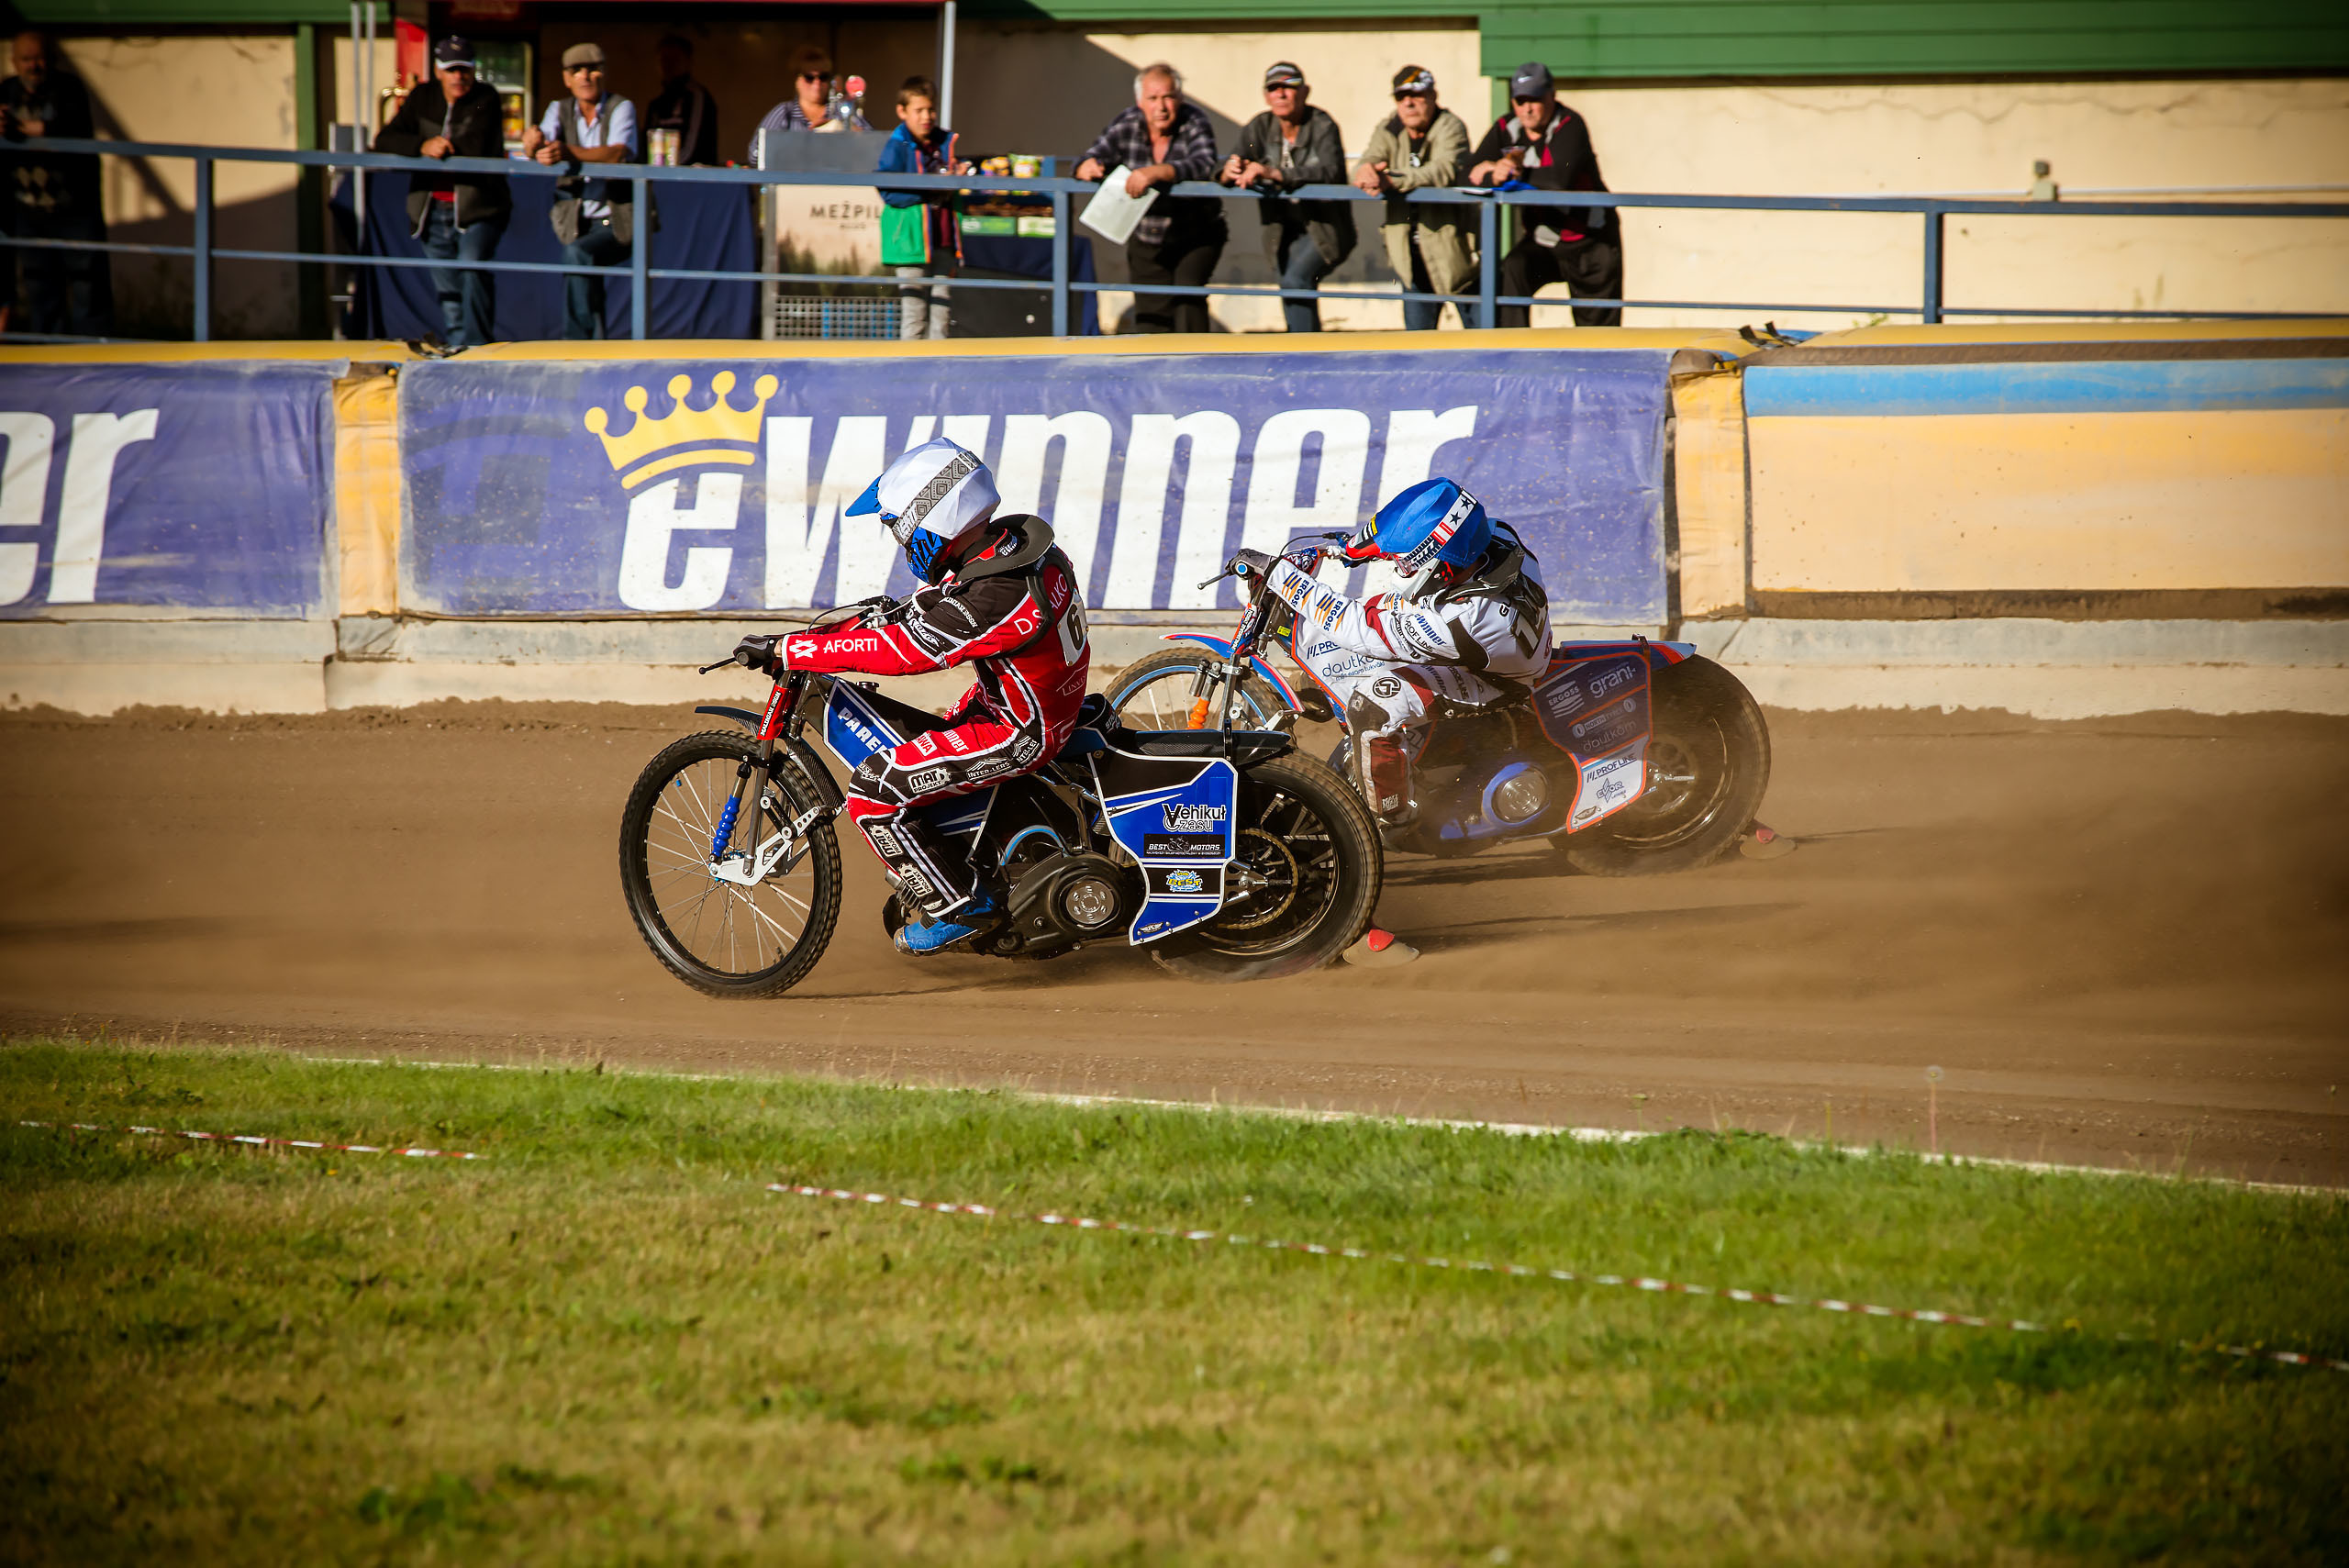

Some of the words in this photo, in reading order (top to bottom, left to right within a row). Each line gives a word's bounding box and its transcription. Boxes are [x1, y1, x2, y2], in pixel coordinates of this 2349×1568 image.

[809, 201, 880, 218] MEŽPIL
[618, 406, 1478, 611] ewnner
[1408, 540, 1435, 564] COTT
[1066, 604, 1083, 651] 6
[1324, 601, 1343, 631] ERGOSS
[823, 638, 878, 653] AFORTI
[1322, 653, 1374, 677] dautko
[1548, 685, 1579, 706] ERGOSS
[916, 735, 932, 753] AWA
[1163, 804, 1226, 827] Vehikuł
